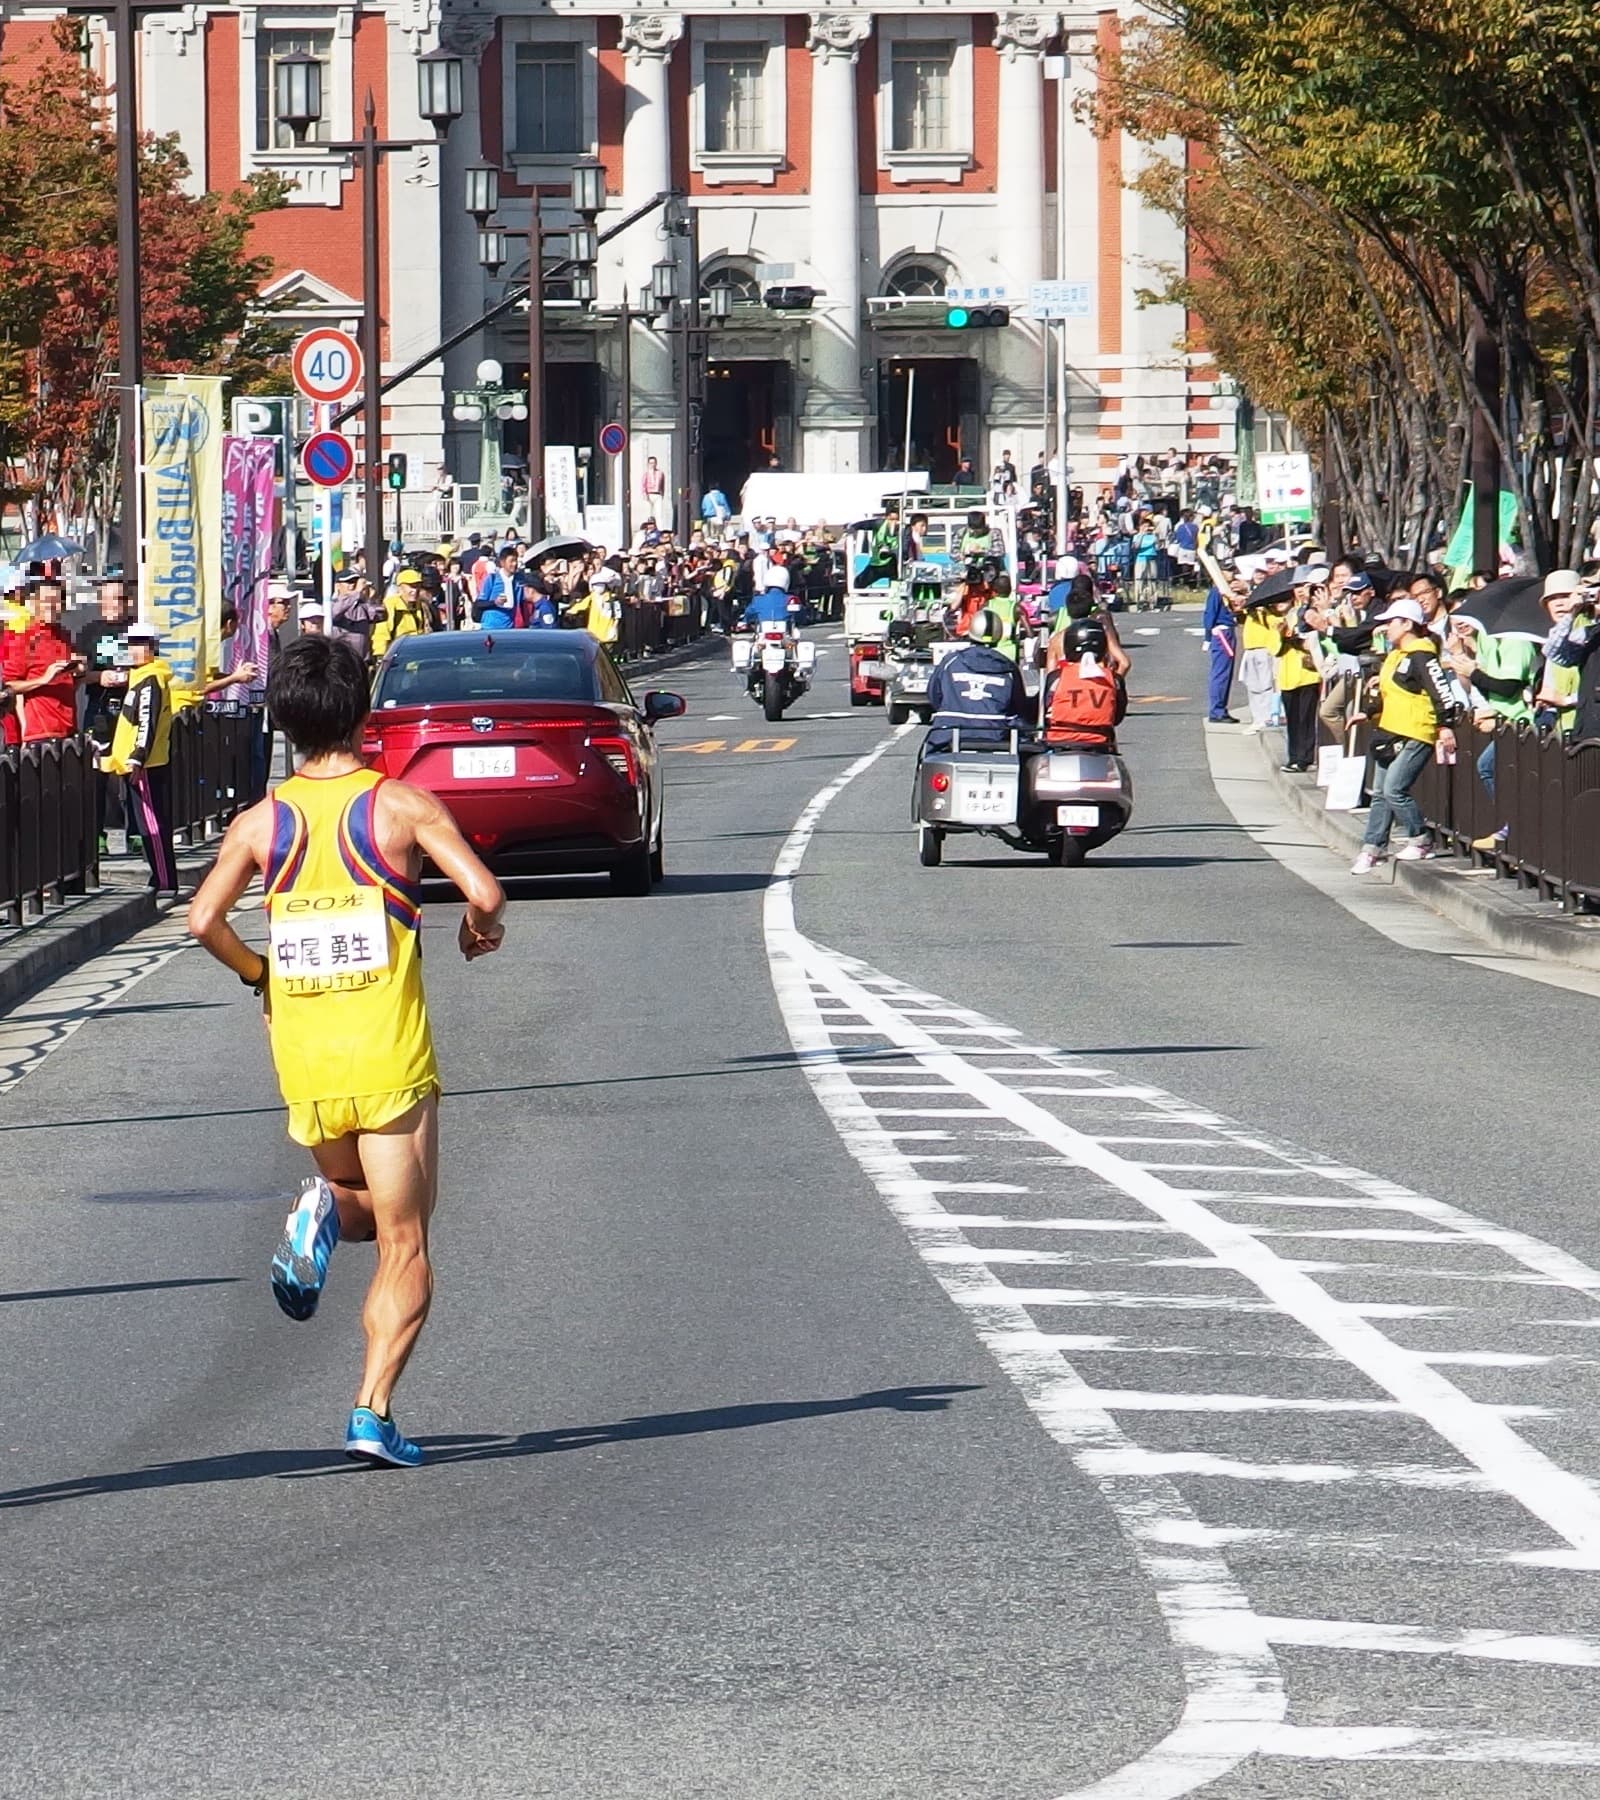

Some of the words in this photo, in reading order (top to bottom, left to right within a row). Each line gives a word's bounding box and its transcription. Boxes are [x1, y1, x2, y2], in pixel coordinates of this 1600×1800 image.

[309, 350, 345, 381] 40
[238, 404, 272, 433] P
[1266, 460, 1300, 472] トイレ
[1068, 689, 1109, 709] TV
[278, 937, 321, 969] 中尾
[331, 933, 372, 965] 勇生
